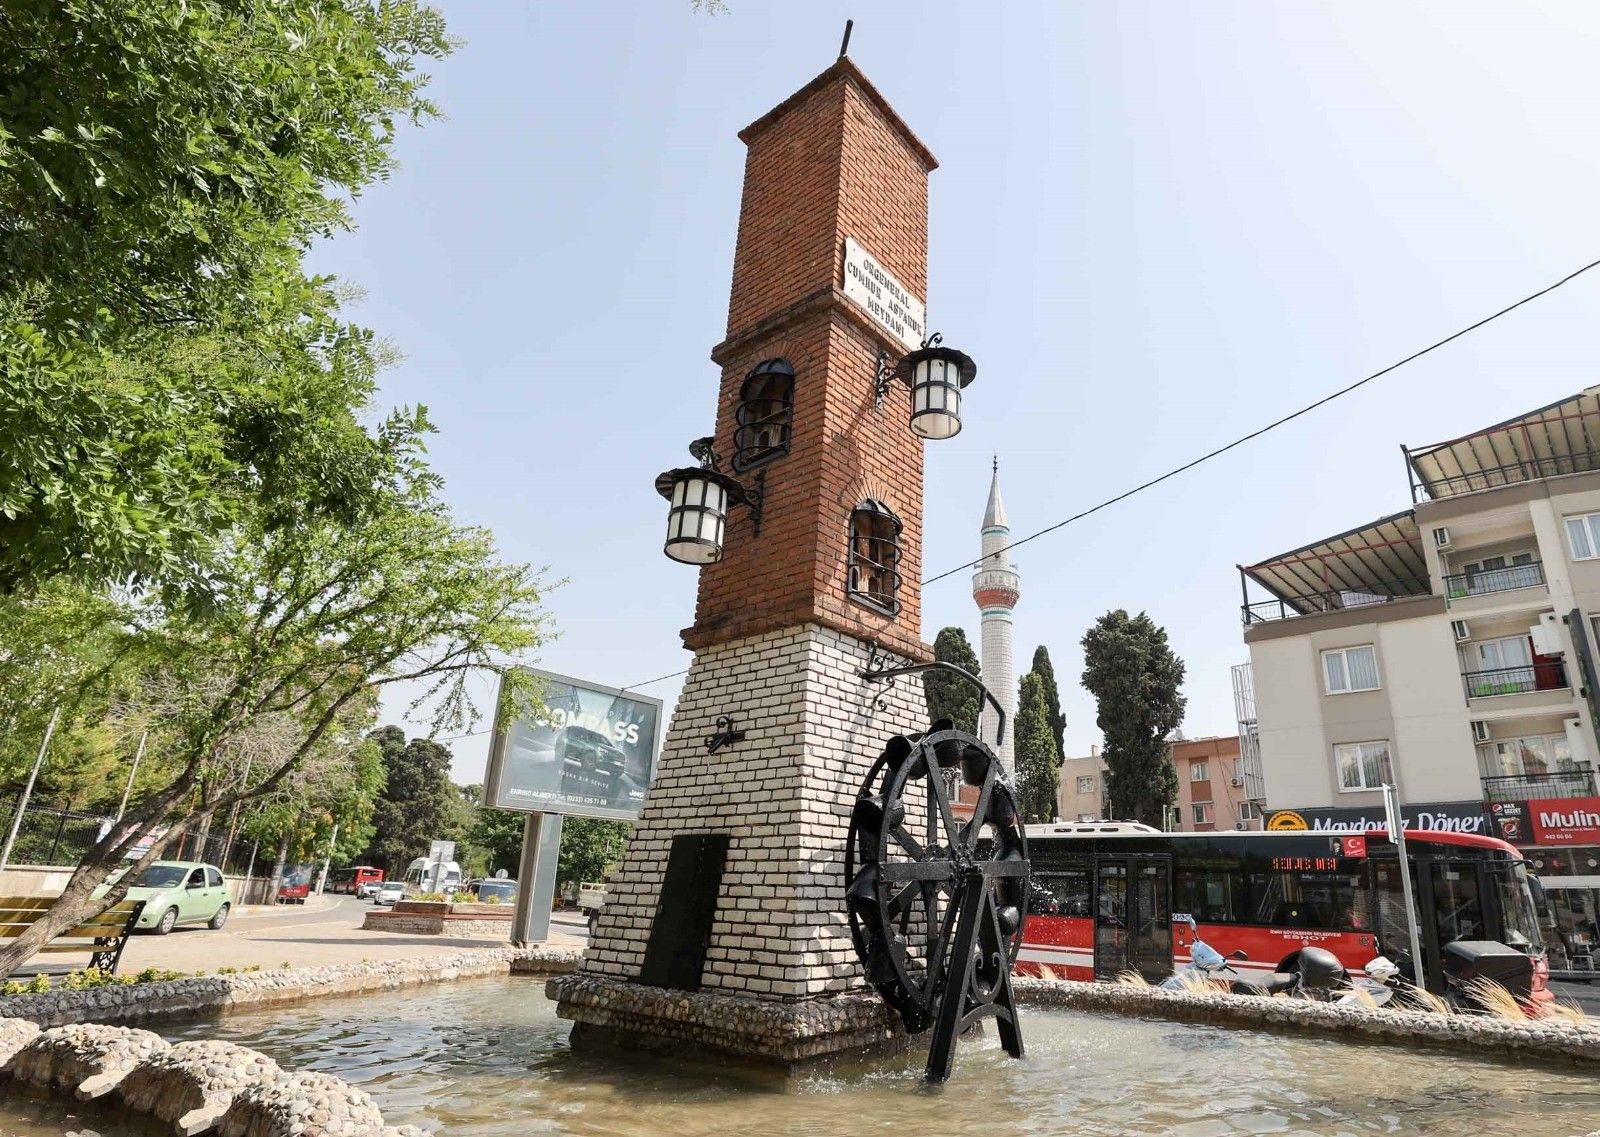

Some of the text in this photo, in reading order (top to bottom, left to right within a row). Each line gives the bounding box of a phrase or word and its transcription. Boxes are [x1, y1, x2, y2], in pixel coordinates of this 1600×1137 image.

[847, 262, 882, 300] CUMHUR
[864, 259, 910, 309] ORGENERAL
[867, 296, 905, 338] MEYDANI
[1417, 812, 1484, 833] Döner
